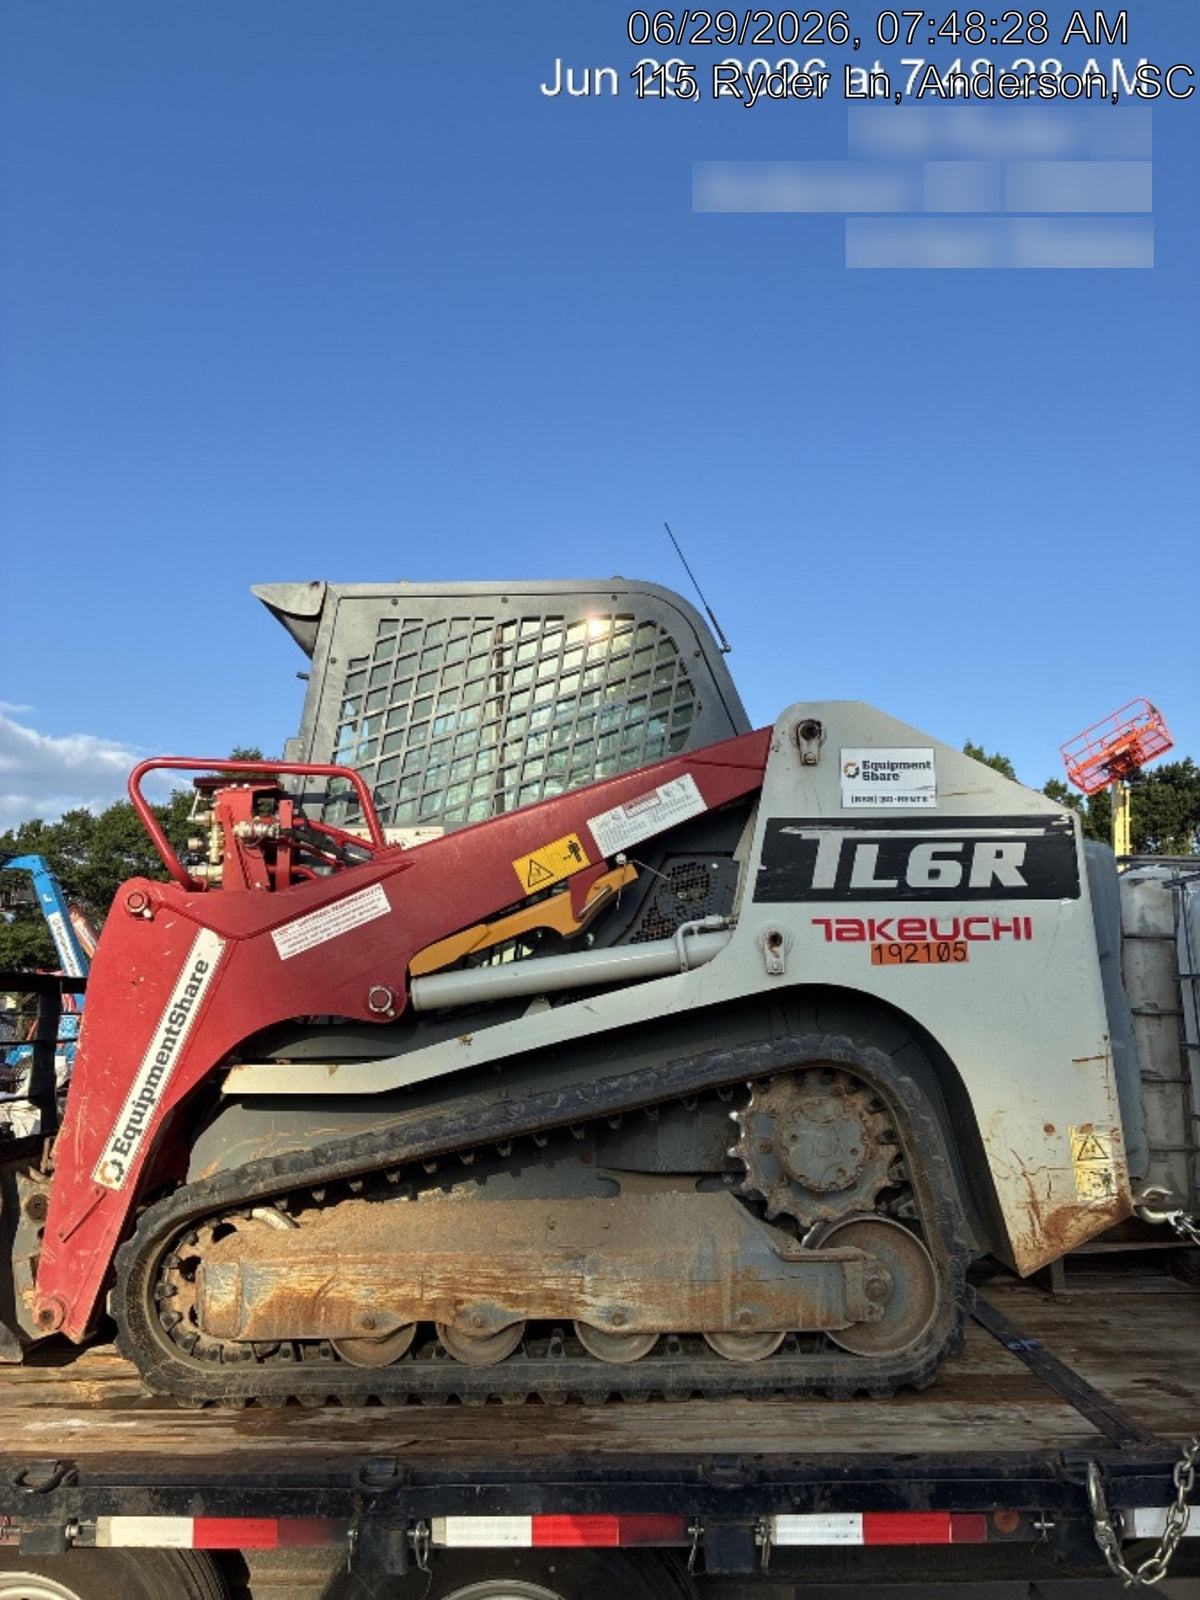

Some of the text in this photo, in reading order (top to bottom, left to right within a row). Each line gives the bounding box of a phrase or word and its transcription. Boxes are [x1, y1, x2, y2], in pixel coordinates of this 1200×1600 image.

[862, 760, 932, 772] Equipment
[862, 771, 900, 781] Share
[790, 827, 1040, 889] TL6R
[873, 942, 967, 963] 192105
[111, 959, 209, 1157] EquipmentShare
